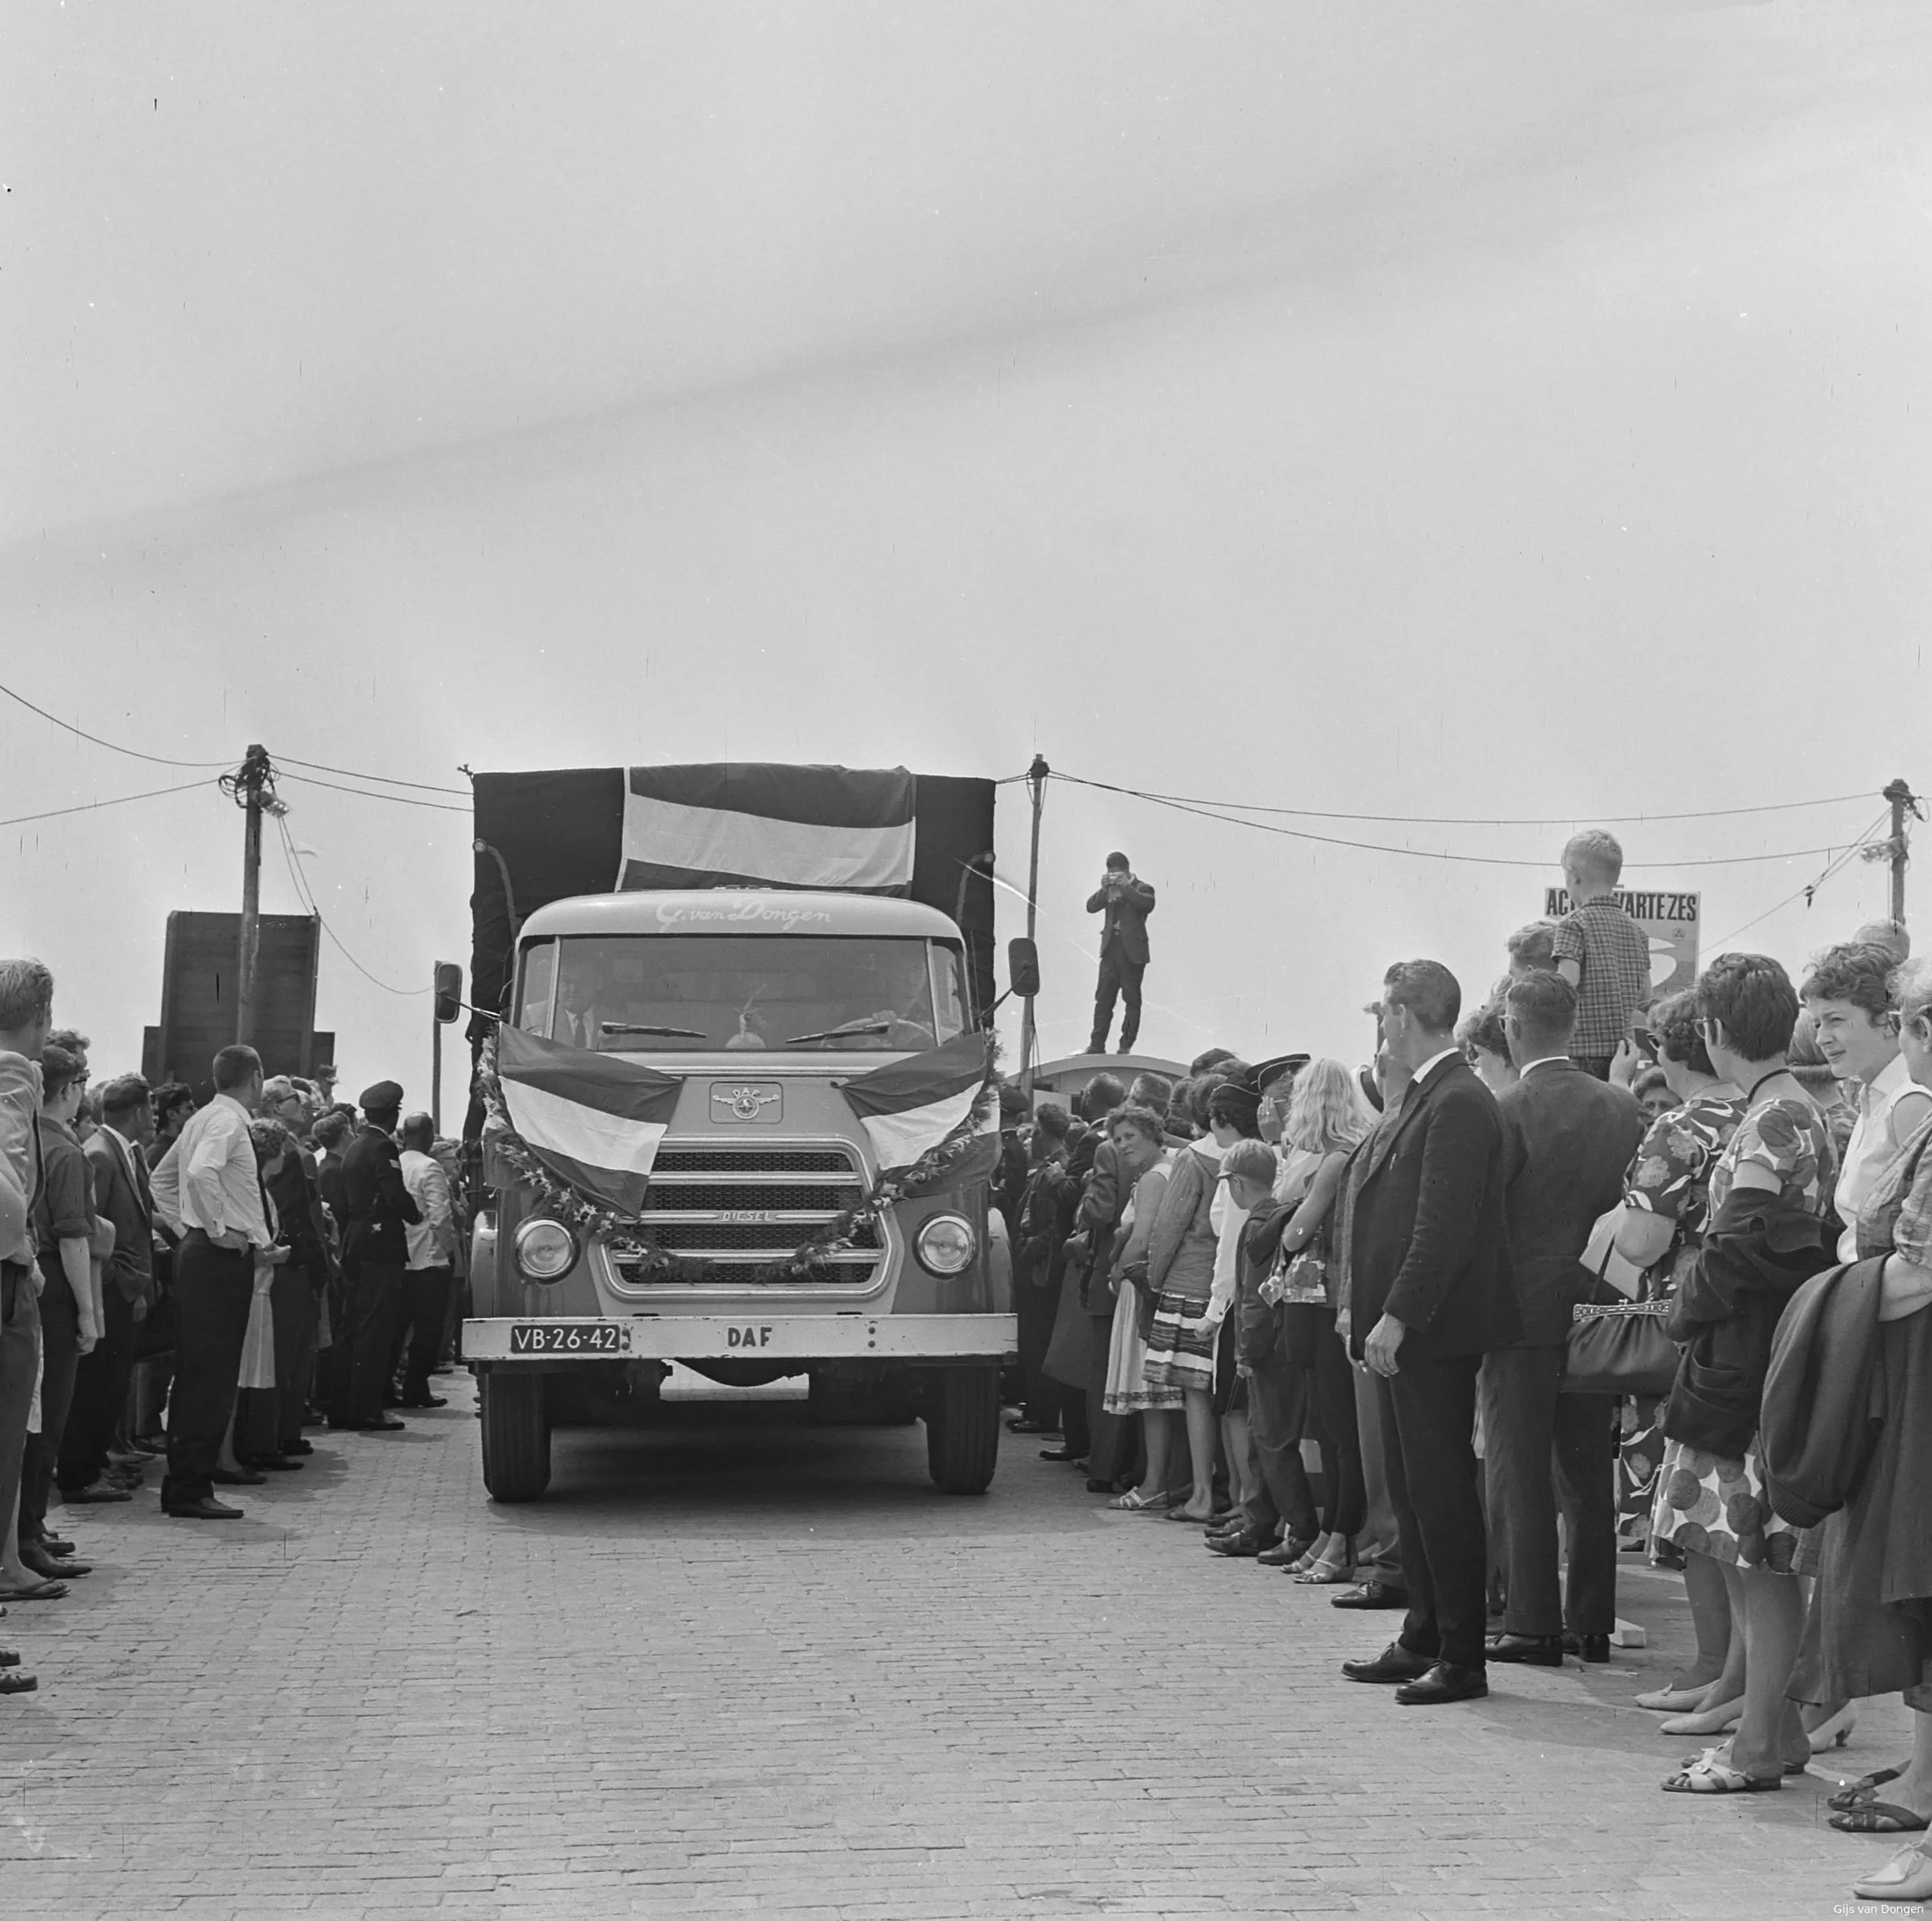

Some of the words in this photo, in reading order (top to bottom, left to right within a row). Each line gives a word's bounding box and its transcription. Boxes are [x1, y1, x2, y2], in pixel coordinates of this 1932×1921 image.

[689, 908, 725, 921] van
[727, 897, 832, 930] Dongen
[733, 1087, 761, 1099] DAF
[722, 1212, 773, 1222] DIESEL
[515, 1328, 616, 1349] VB-26-42
[728, 1327, 773, 1347] DAF
